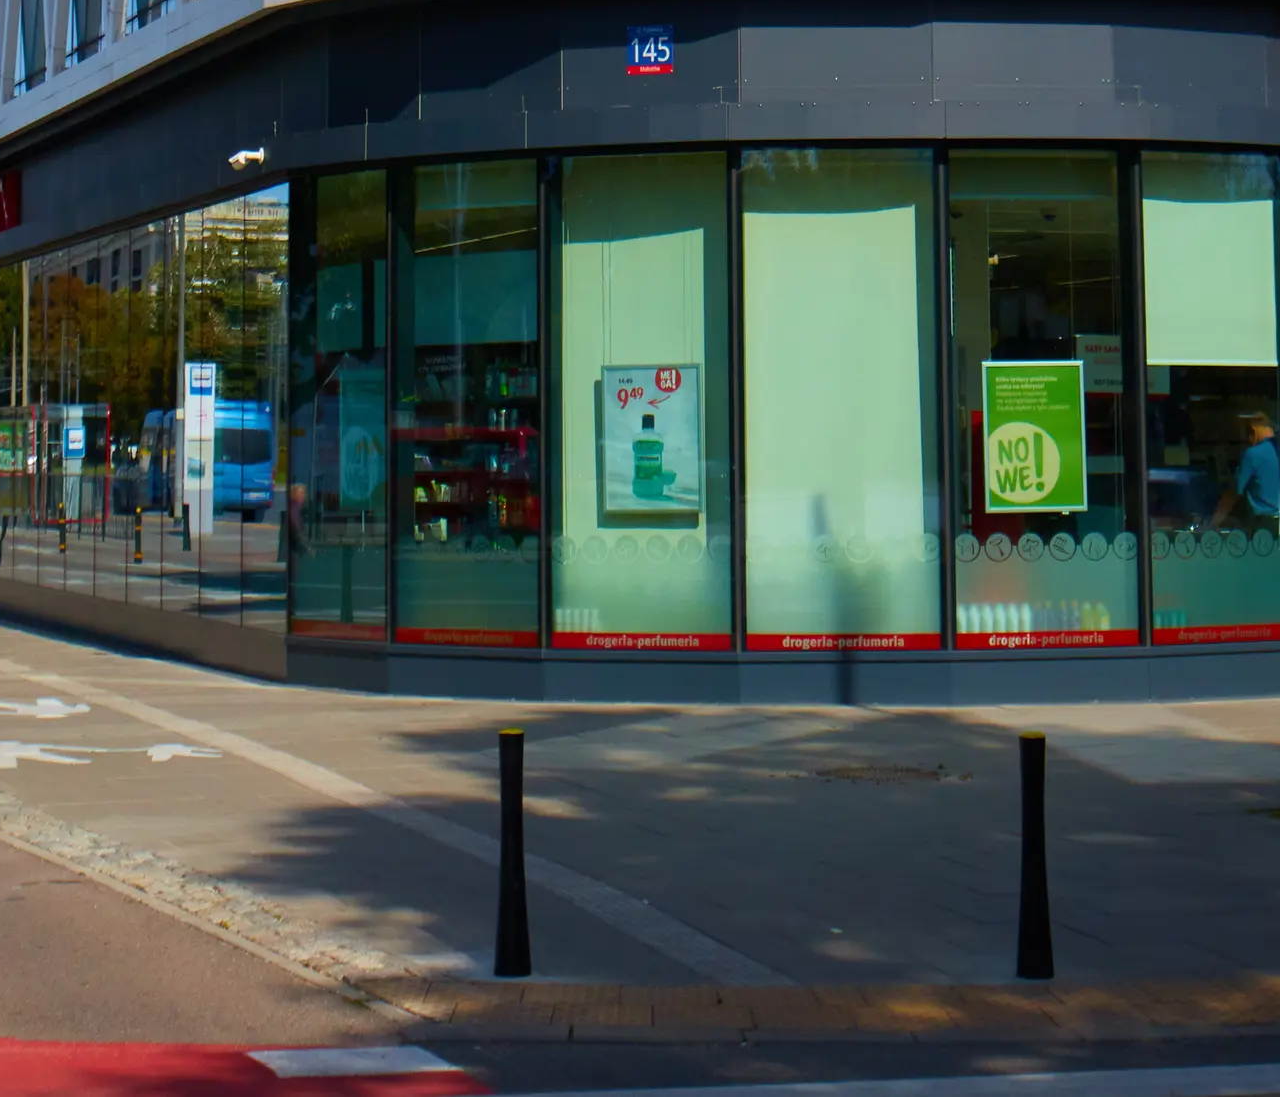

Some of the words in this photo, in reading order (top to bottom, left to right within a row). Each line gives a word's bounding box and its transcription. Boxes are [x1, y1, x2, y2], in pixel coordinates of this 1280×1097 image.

[631, 37, 671, 63] 145
[997, 436, 1030, 465] NO
[586, 634, 700, 649] drogeria-perfumeria
[782, 635, 905, 650] drogeria-perfumeria
[988, 632, 1104, 647] drogeria-perfumeria
